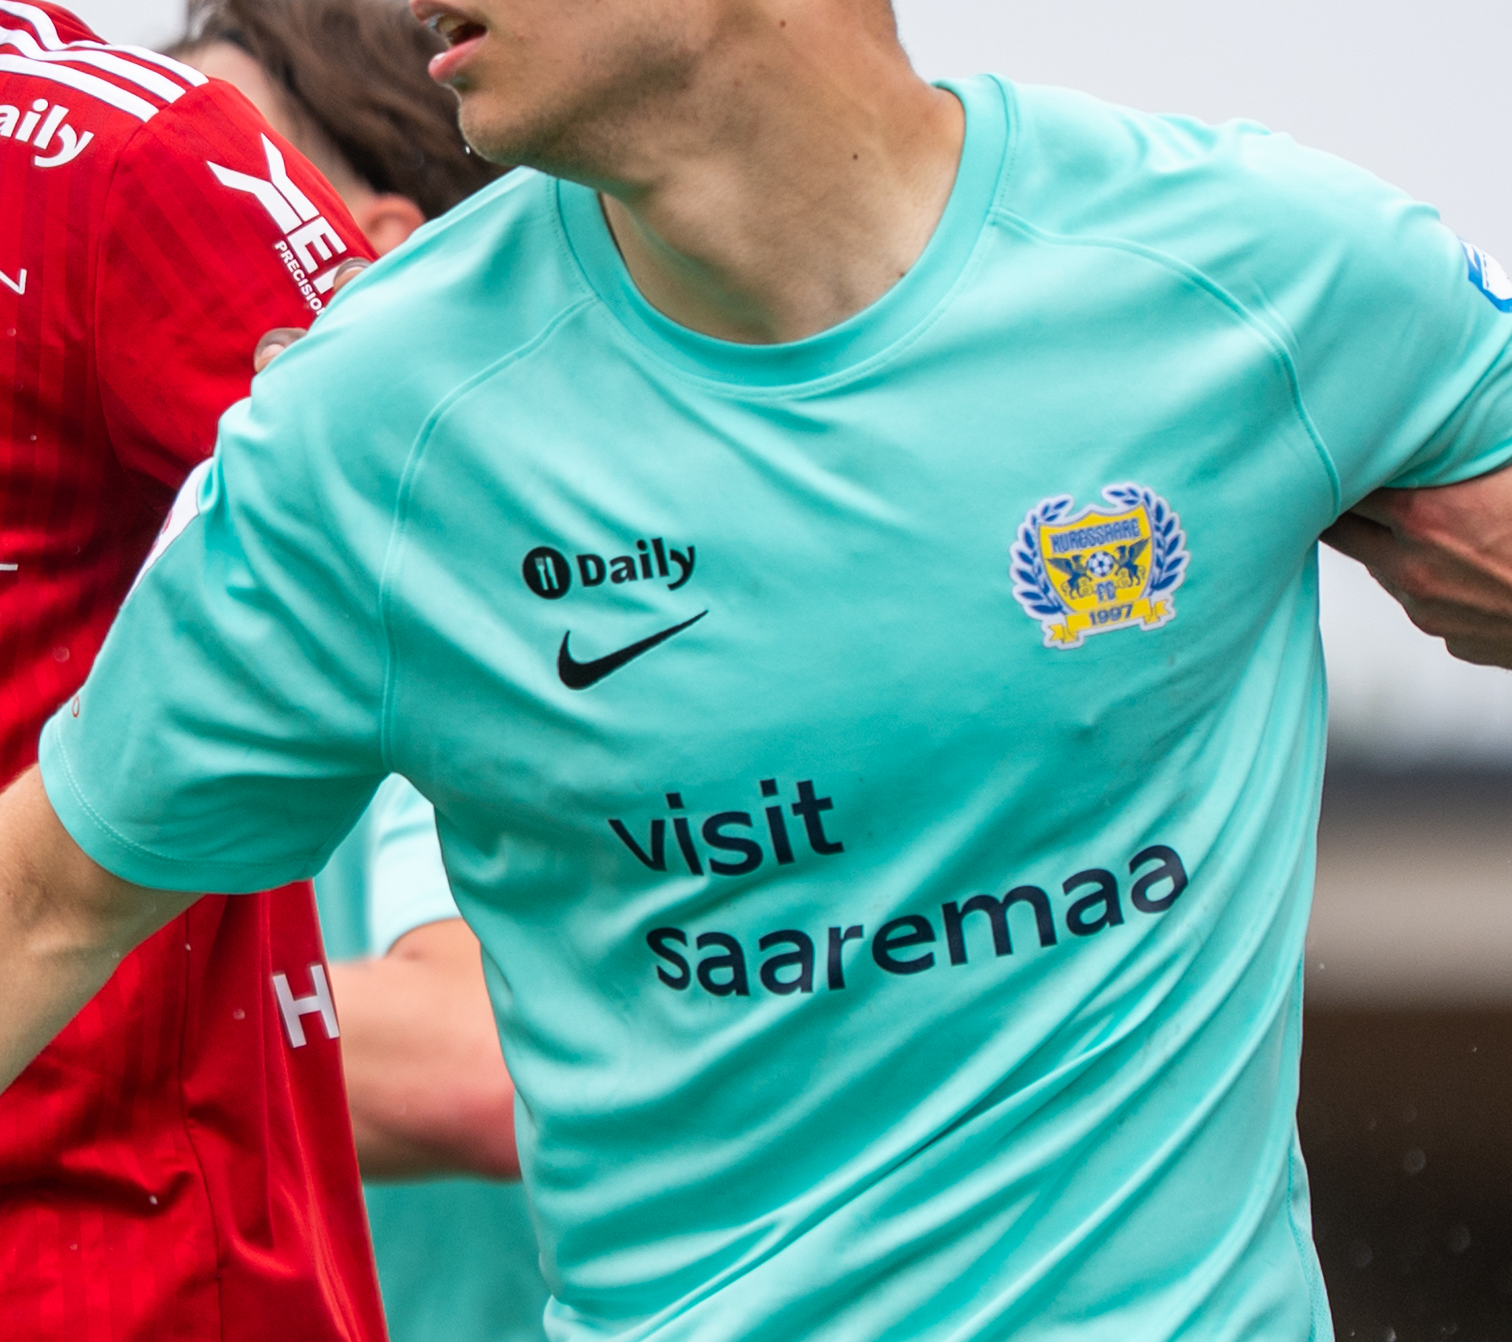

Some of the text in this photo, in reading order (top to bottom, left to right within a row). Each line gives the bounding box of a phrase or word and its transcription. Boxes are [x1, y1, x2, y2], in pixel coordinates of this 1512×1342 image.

[576, 537, 696, 591] Daily
[1089, 604, 1134, 626] 1997
[607, 778, 846, 877] visit
[645, 844, 1190, 997] saaremaa
